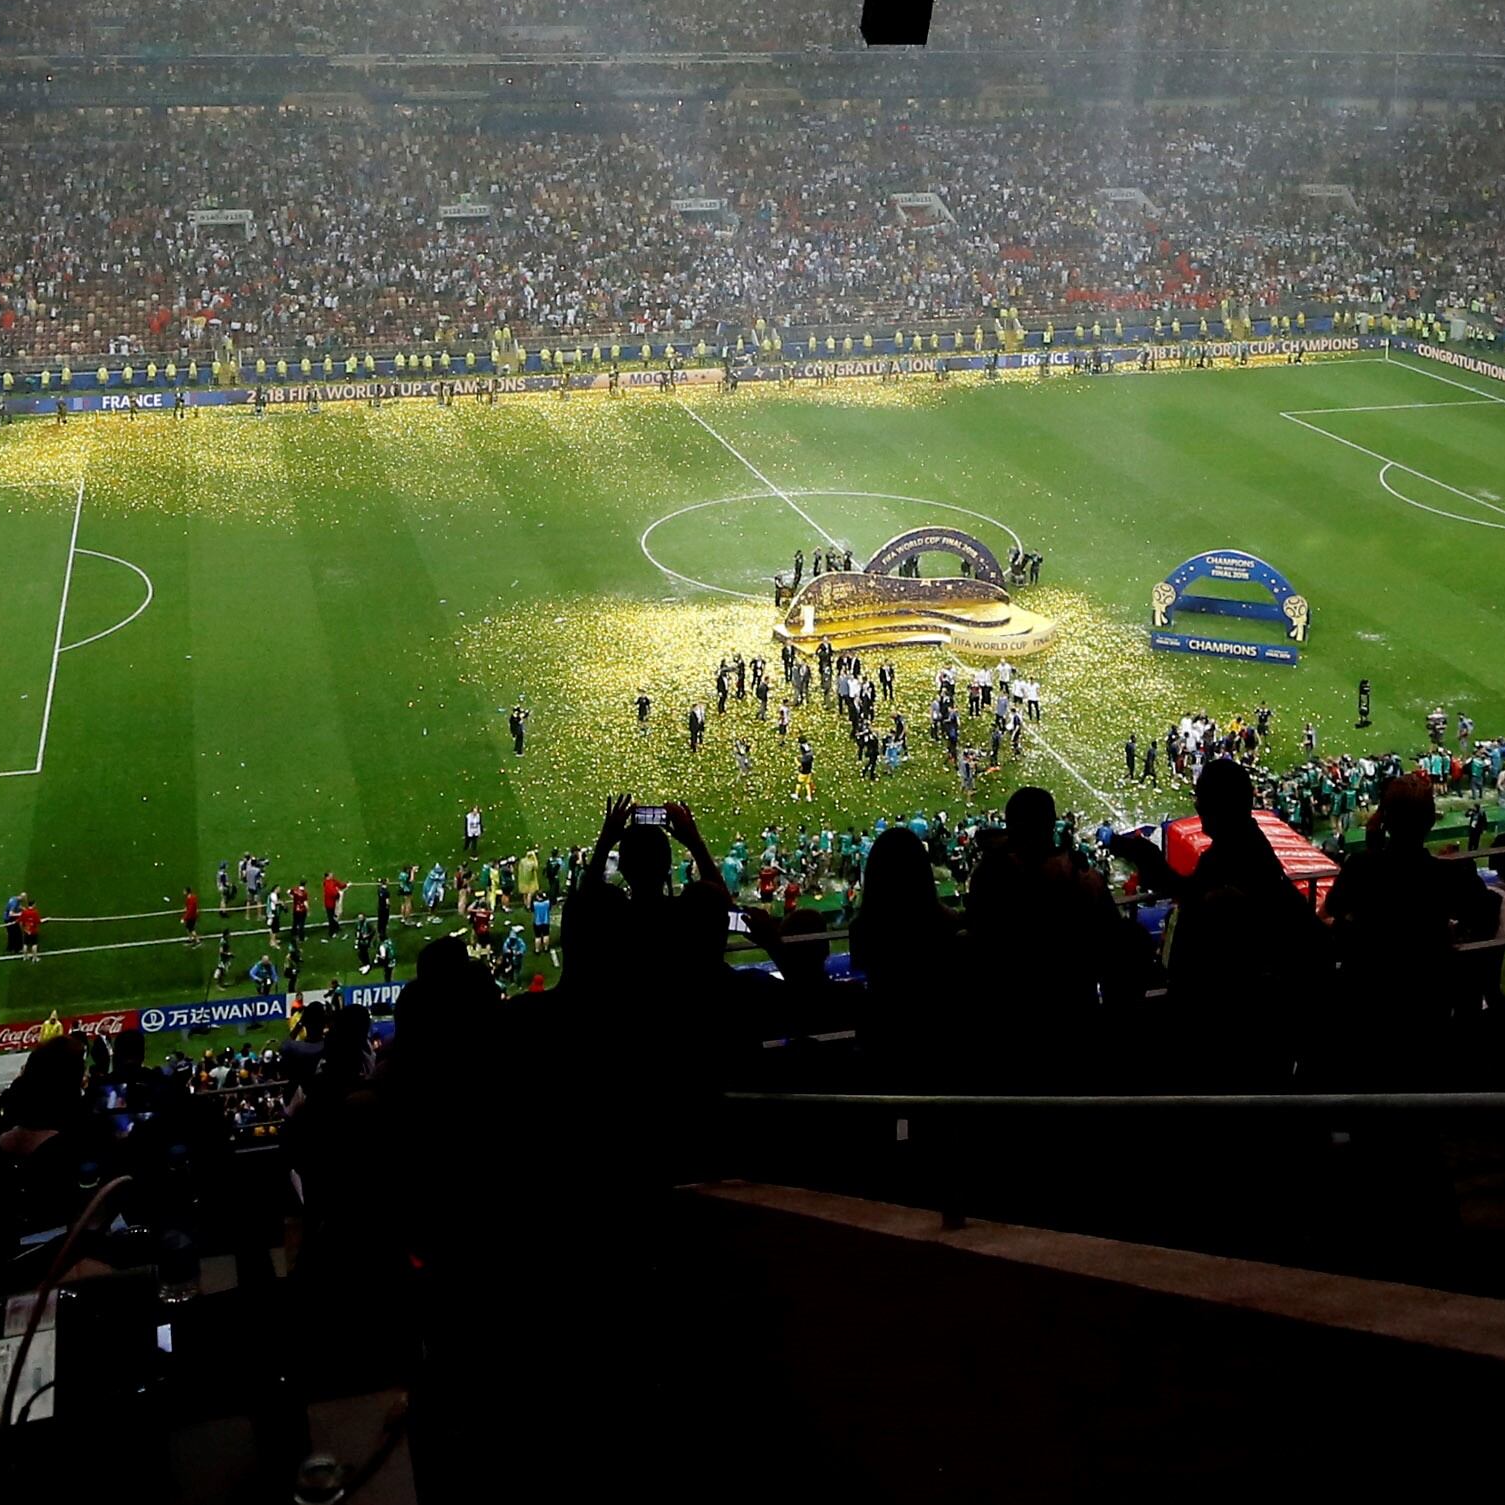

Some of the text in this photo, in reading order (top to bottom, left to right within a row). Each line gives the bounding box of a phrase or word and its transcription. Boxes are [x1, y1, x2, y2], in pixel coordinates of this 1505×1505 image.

[1282, 338, 1359, 352] CHAMPIONS
[247, 389, 284, 404] 218
[895, 538, 924, 554] WORLD
[1206, 556, 1255, 568] CHAMPIONS
[973, 642, 1009, 651] WORLD
[1188, 639, 1258, 657] CHAMPIONS
[168, 1006, 211, 1027] 万达
[210, 999, 284, 1021] WANDA
